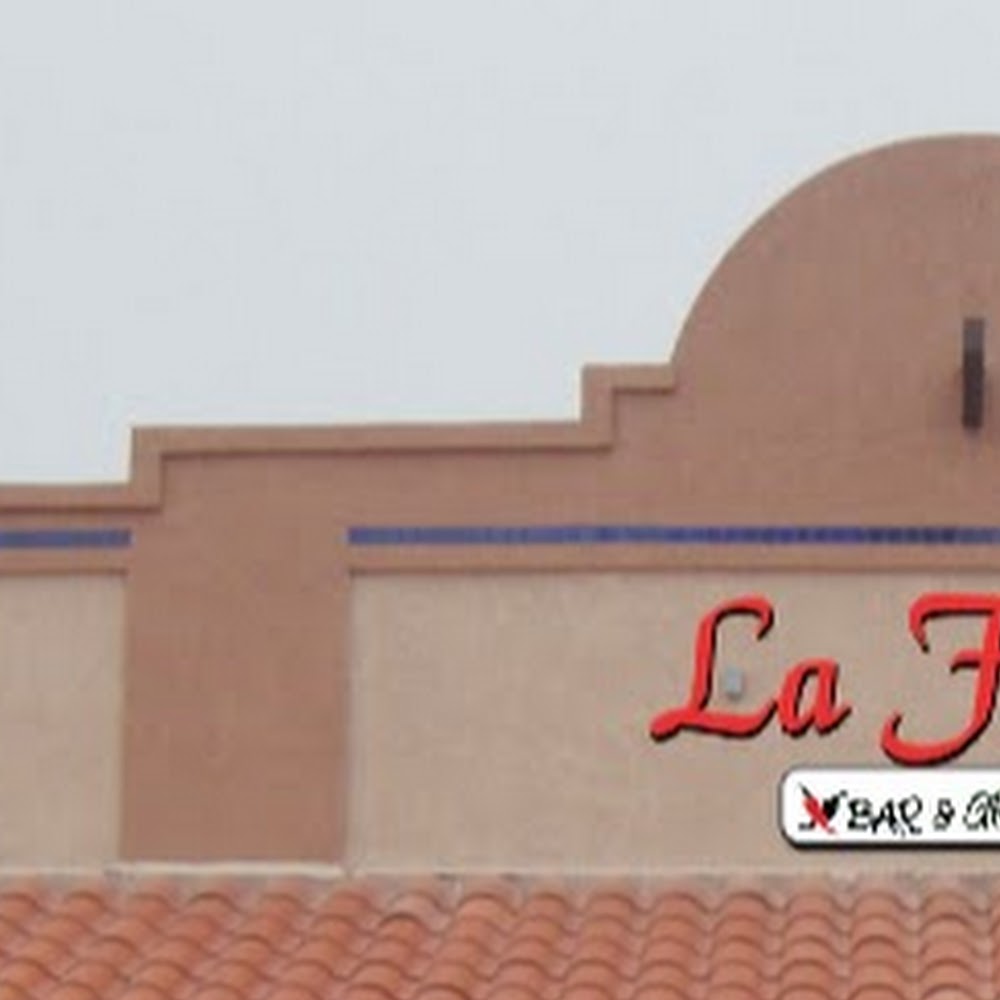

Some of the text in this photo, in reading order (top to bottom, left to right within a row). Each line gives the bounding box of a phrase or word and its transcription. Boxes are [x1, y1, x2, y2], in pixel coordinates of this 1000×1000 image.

[649, 595, 851, 740] La
[846, 794, 923, 836] BAR
[934, 798, 956, 831] &
